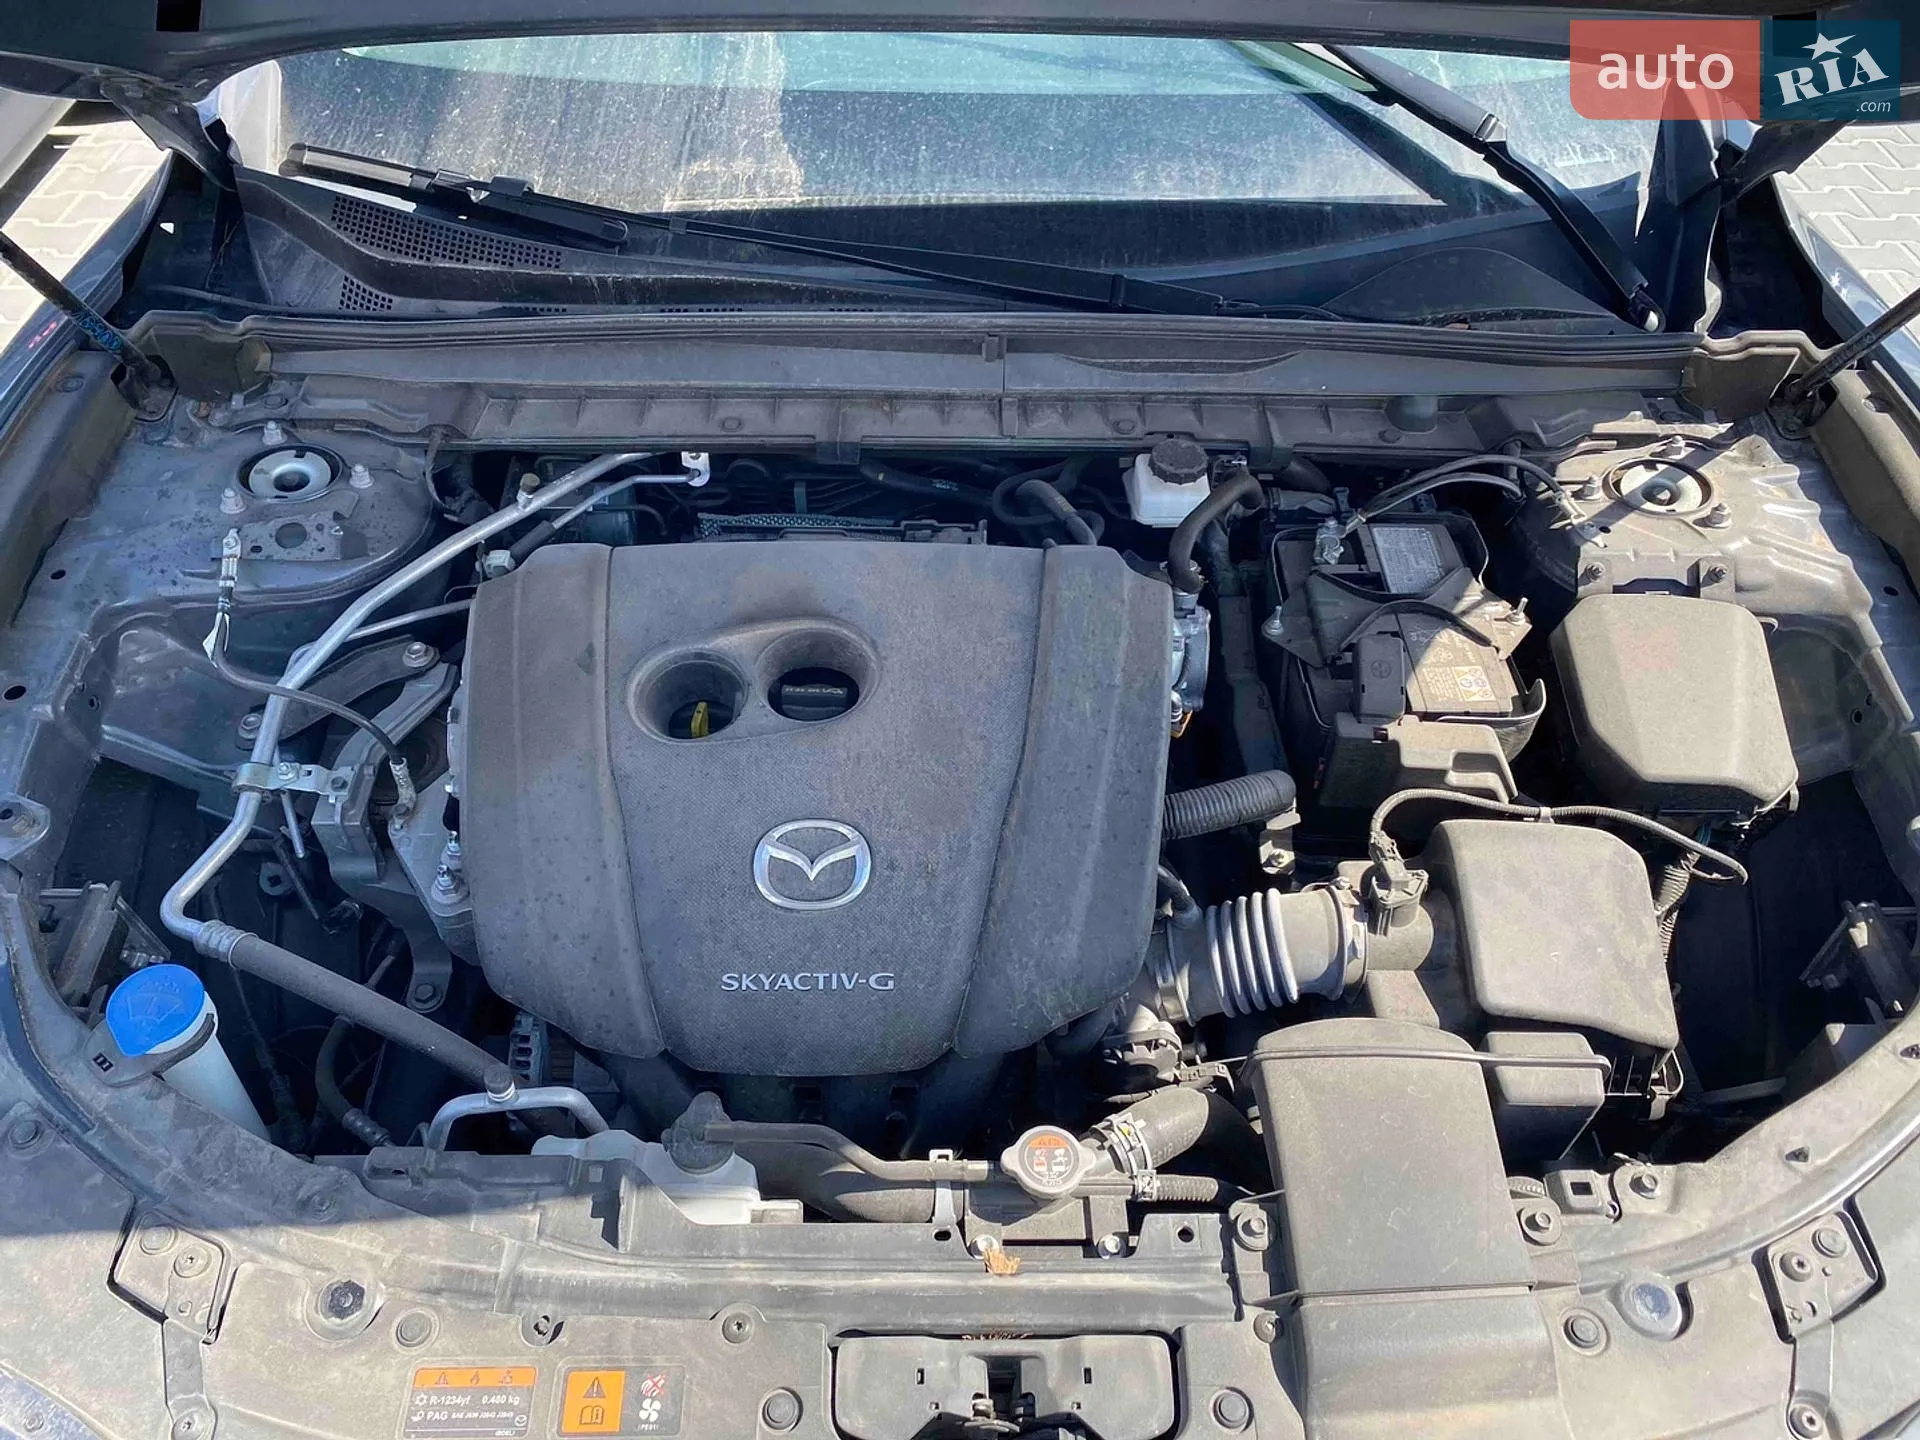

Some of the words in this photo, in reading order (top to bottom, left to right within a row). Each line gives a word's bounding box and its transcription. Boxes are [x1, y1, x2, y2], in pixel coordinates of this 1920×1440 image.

[721, 972, 895, 991] SKYACTIV-G
[429, 1395, 471, 1406] R-1234yf
[508, 1395, 520, 1406] kg
[427, 1411, 448, 1420] PAG
